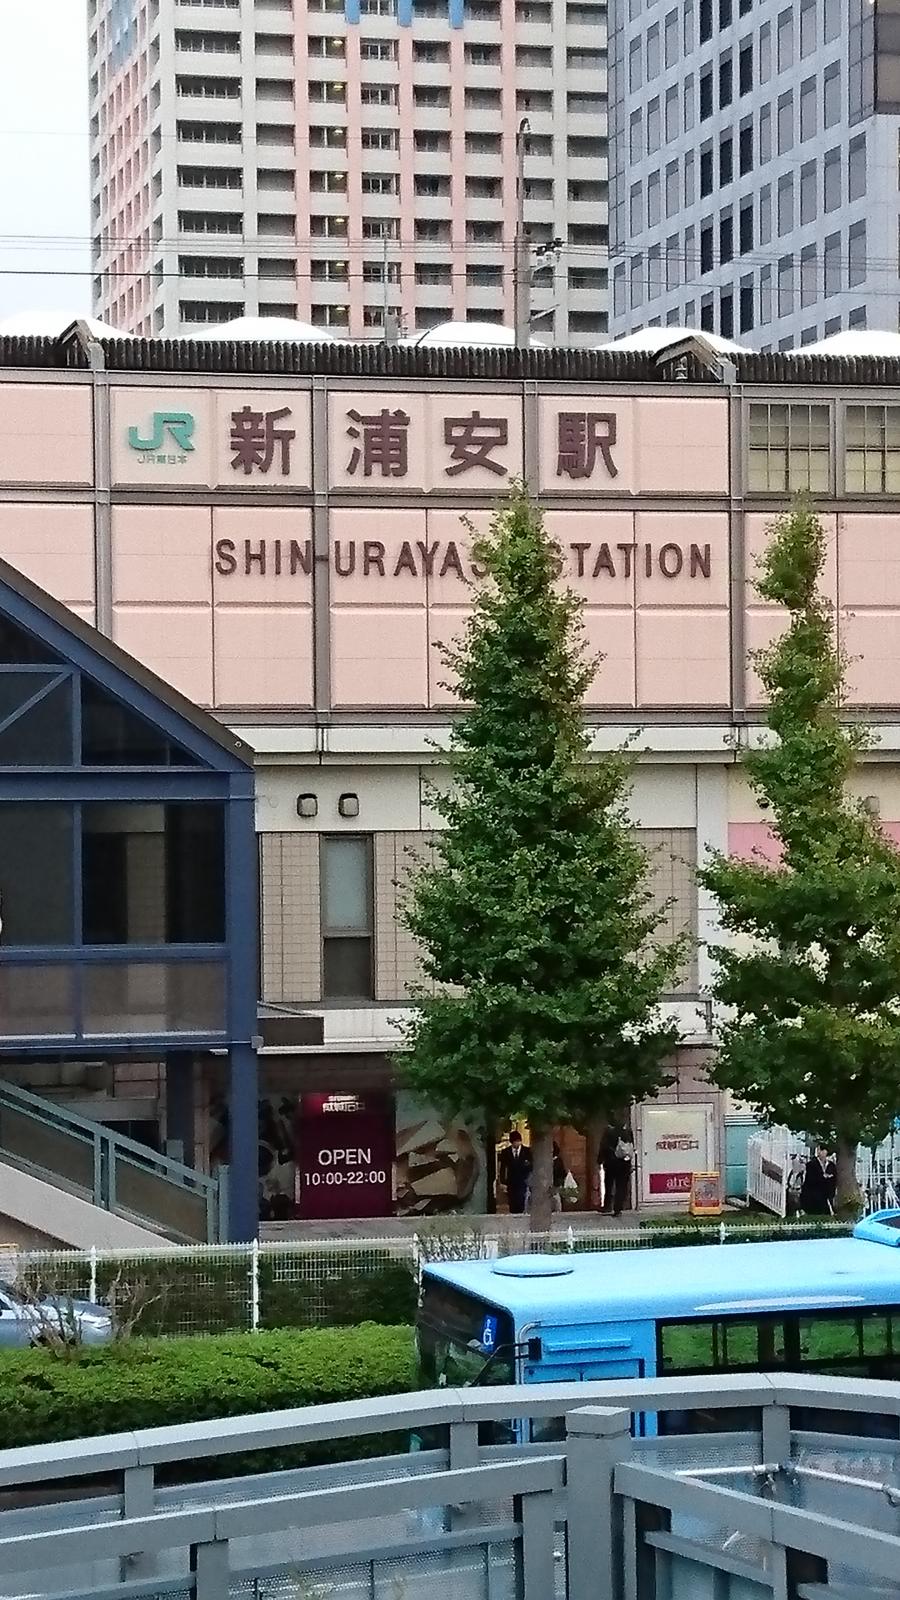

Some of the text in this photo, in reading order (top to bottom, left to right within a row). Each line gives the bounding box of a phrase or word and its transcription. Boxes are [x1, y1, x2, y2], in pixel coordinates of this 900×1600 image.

[128, 412, 195, 451] JR
[230, 405, 618, 479] 新浦安駅
[318, 1148, 371, 1166] OPEN
[304, 1170, 386, 1186] 10:00-22:00
